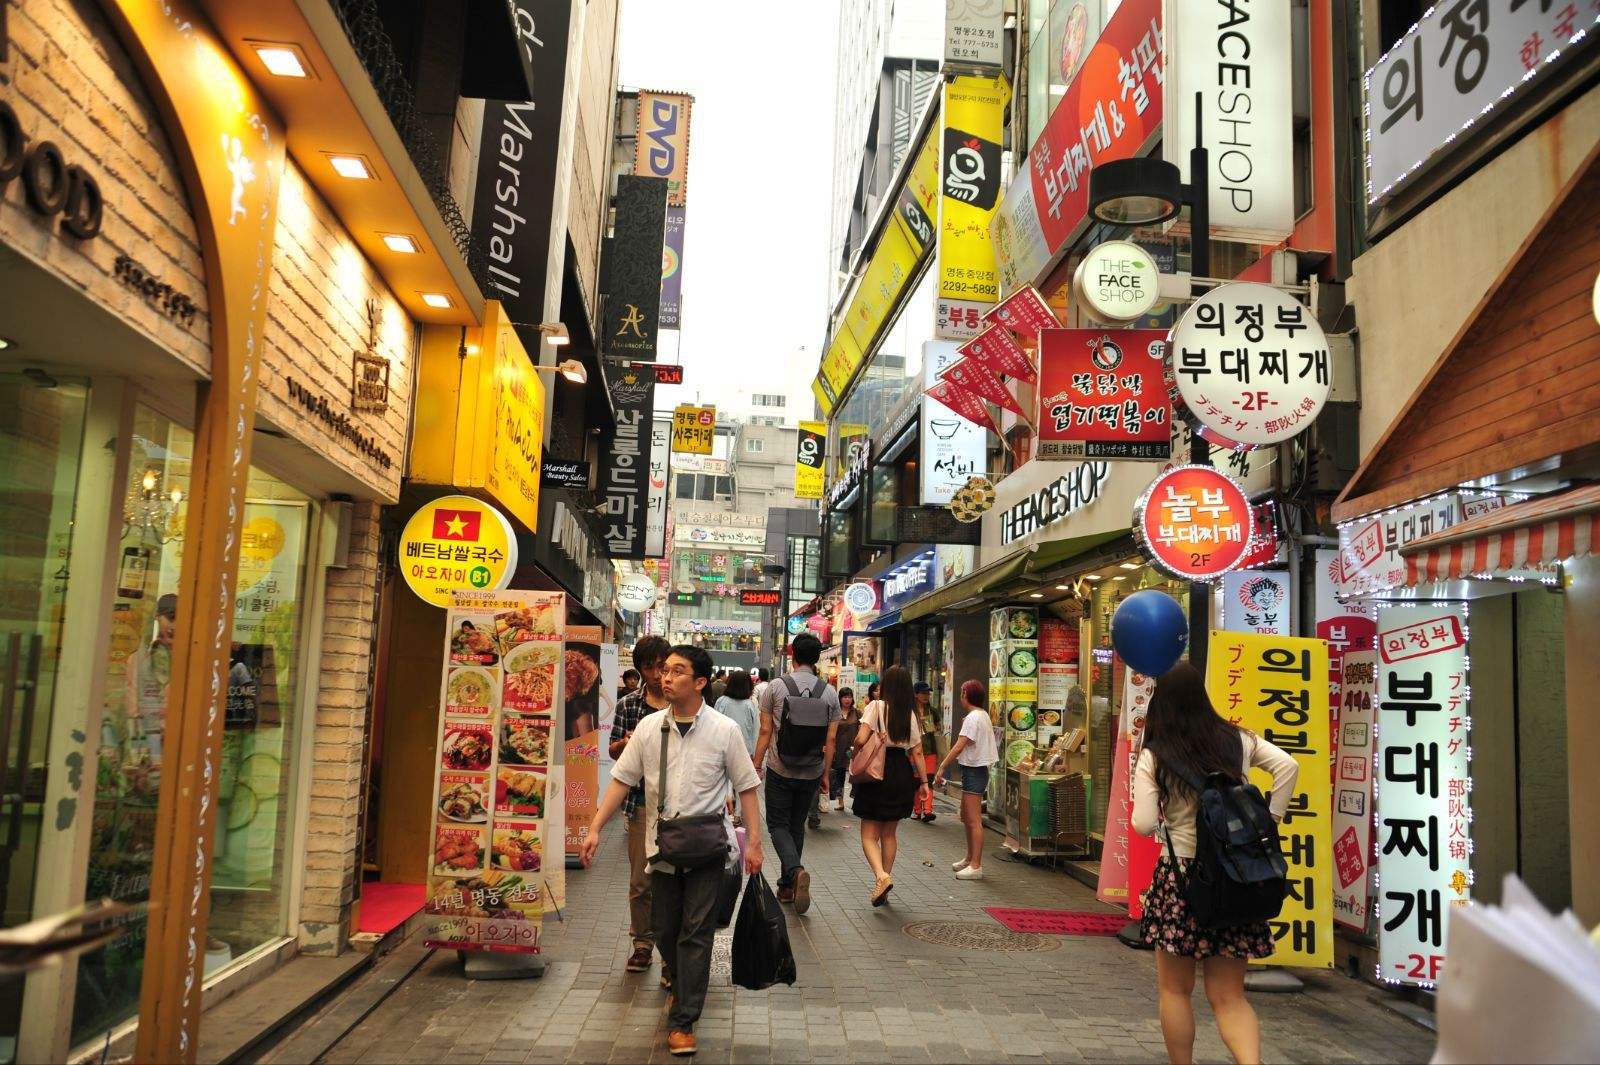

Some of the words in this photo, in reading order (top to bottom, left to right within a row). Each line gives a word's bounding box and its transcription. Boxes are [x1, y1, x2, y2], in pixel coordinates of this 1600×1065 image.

[1217, 0, 1253, 213] ACESHOP
[646, 98, 678, 177] DVD
[487, 101, 536, 298] Marshall
[1100, 259, 1132, 272] THE
[943, 281, 997, 295] 2292-5892
[1099, 275, 1141, 288] FACE
[1099, 288, 1145, 303] SHOP
[1194, 302, 1308, 343] 의정부
[1150, 344, 1165, 356] 5F
[1178, 348, 1329, 385] 부대찌개
[1071, 372, 1142, 396] 불닭발
[1232, 391, 1279, 411] -2F-
[675, 412, 697, 424] 명동
[1051, 399, 1166, 434] 엽기떡볶이
[673, 428, 713, 447] 사주카페
[542, 463, 578, 474] Marshall
[546, 473, 569, 482] Beauty
[604, 410, 644, 554] 살롱드마샬
[1160, 485, 1230, 523] 놀부
[1155, 522, 1242, 547] 부대찌개
[406, 541, 504, 564] 베트남쌀국수
[1190, 553, 1211, 568] 2F
[412, 564, 467, 584] 아오자이
[472, 569, 489, 584] B1
[617, 592, 653, 601] MOLY
[620, 583, 653, 594] TONY
[1244, 613, 1279, 625] 놀부
[1389, 625, 1450, 653] 의정부
[1257, 648, 1317, 756] 의정부
[1380, 671, 1443, 948] 부대찌개
[471, 887, 503, 907] 명동
[465, 922, 538, 946] 아오자이
